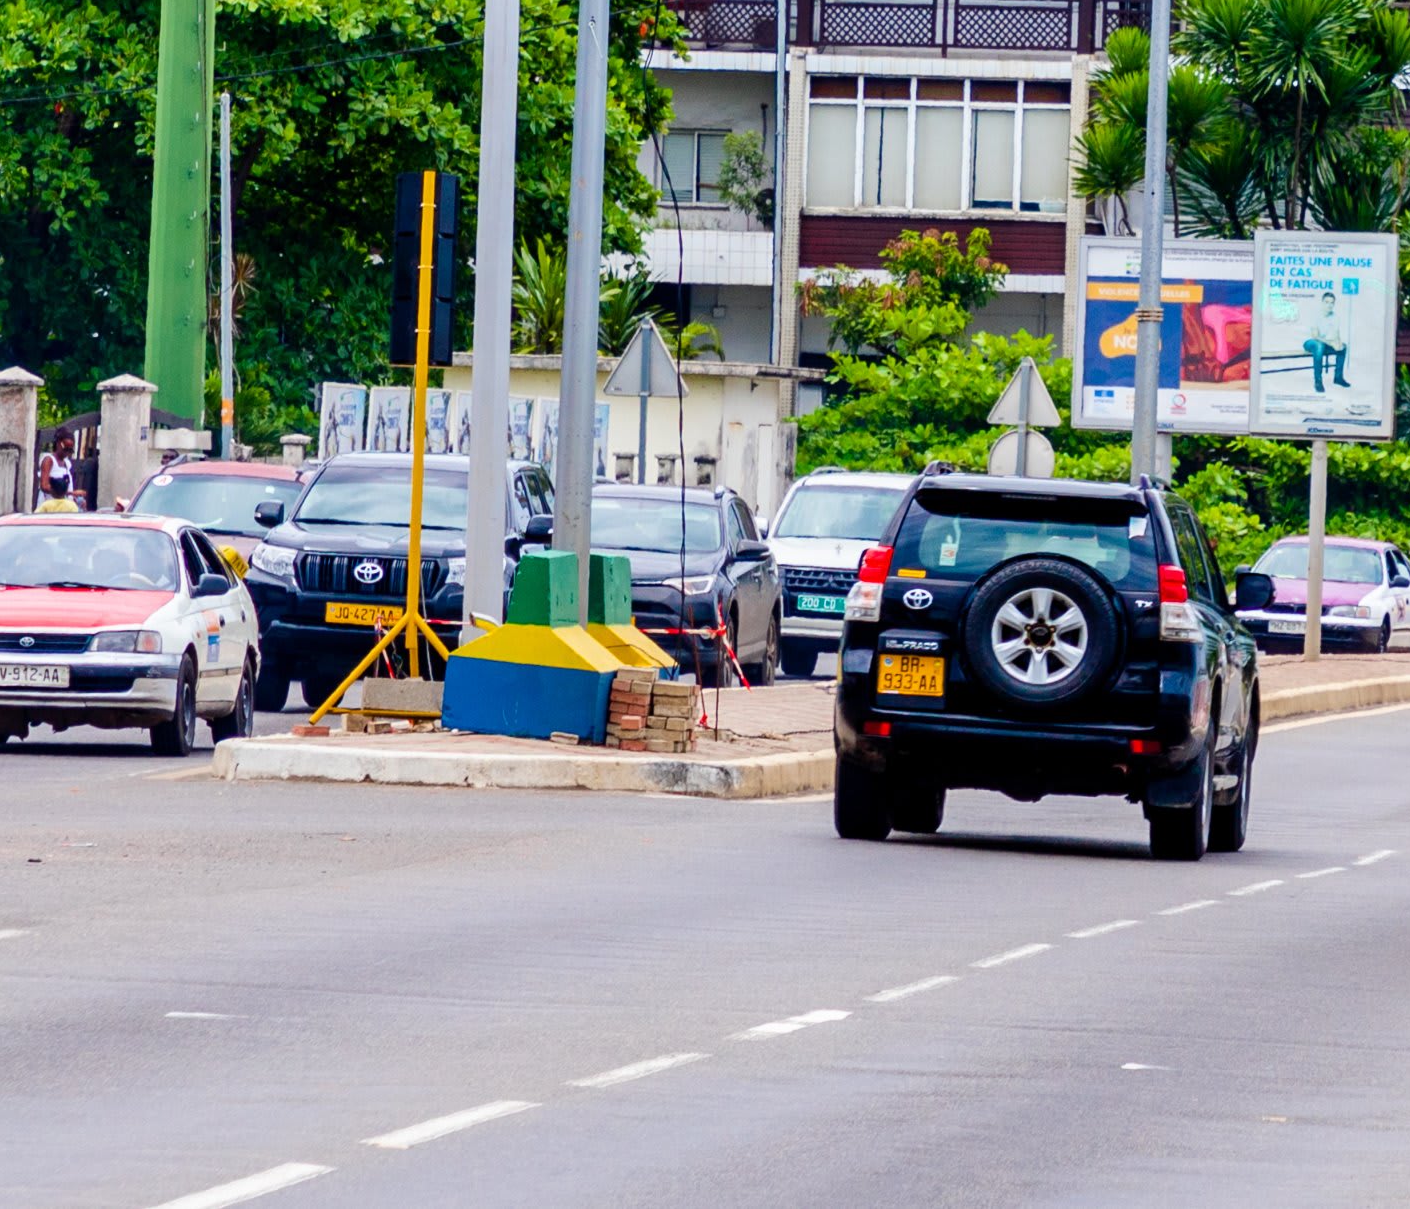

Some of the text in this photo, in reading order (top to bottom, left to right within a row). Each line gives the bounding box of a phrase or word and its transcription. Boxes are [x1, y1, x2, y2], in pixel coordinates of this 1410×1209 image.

[1270, 255, 1373, 268] FAITES UNE PAUSE
[1270, 267, 1312, 277] EN CAS
[1269, 278, 1334, 290] DE FATIGUE
[1098, 287, 1139, 297] VIOLENCE
[883, 673, 938, 691] 933-AA
